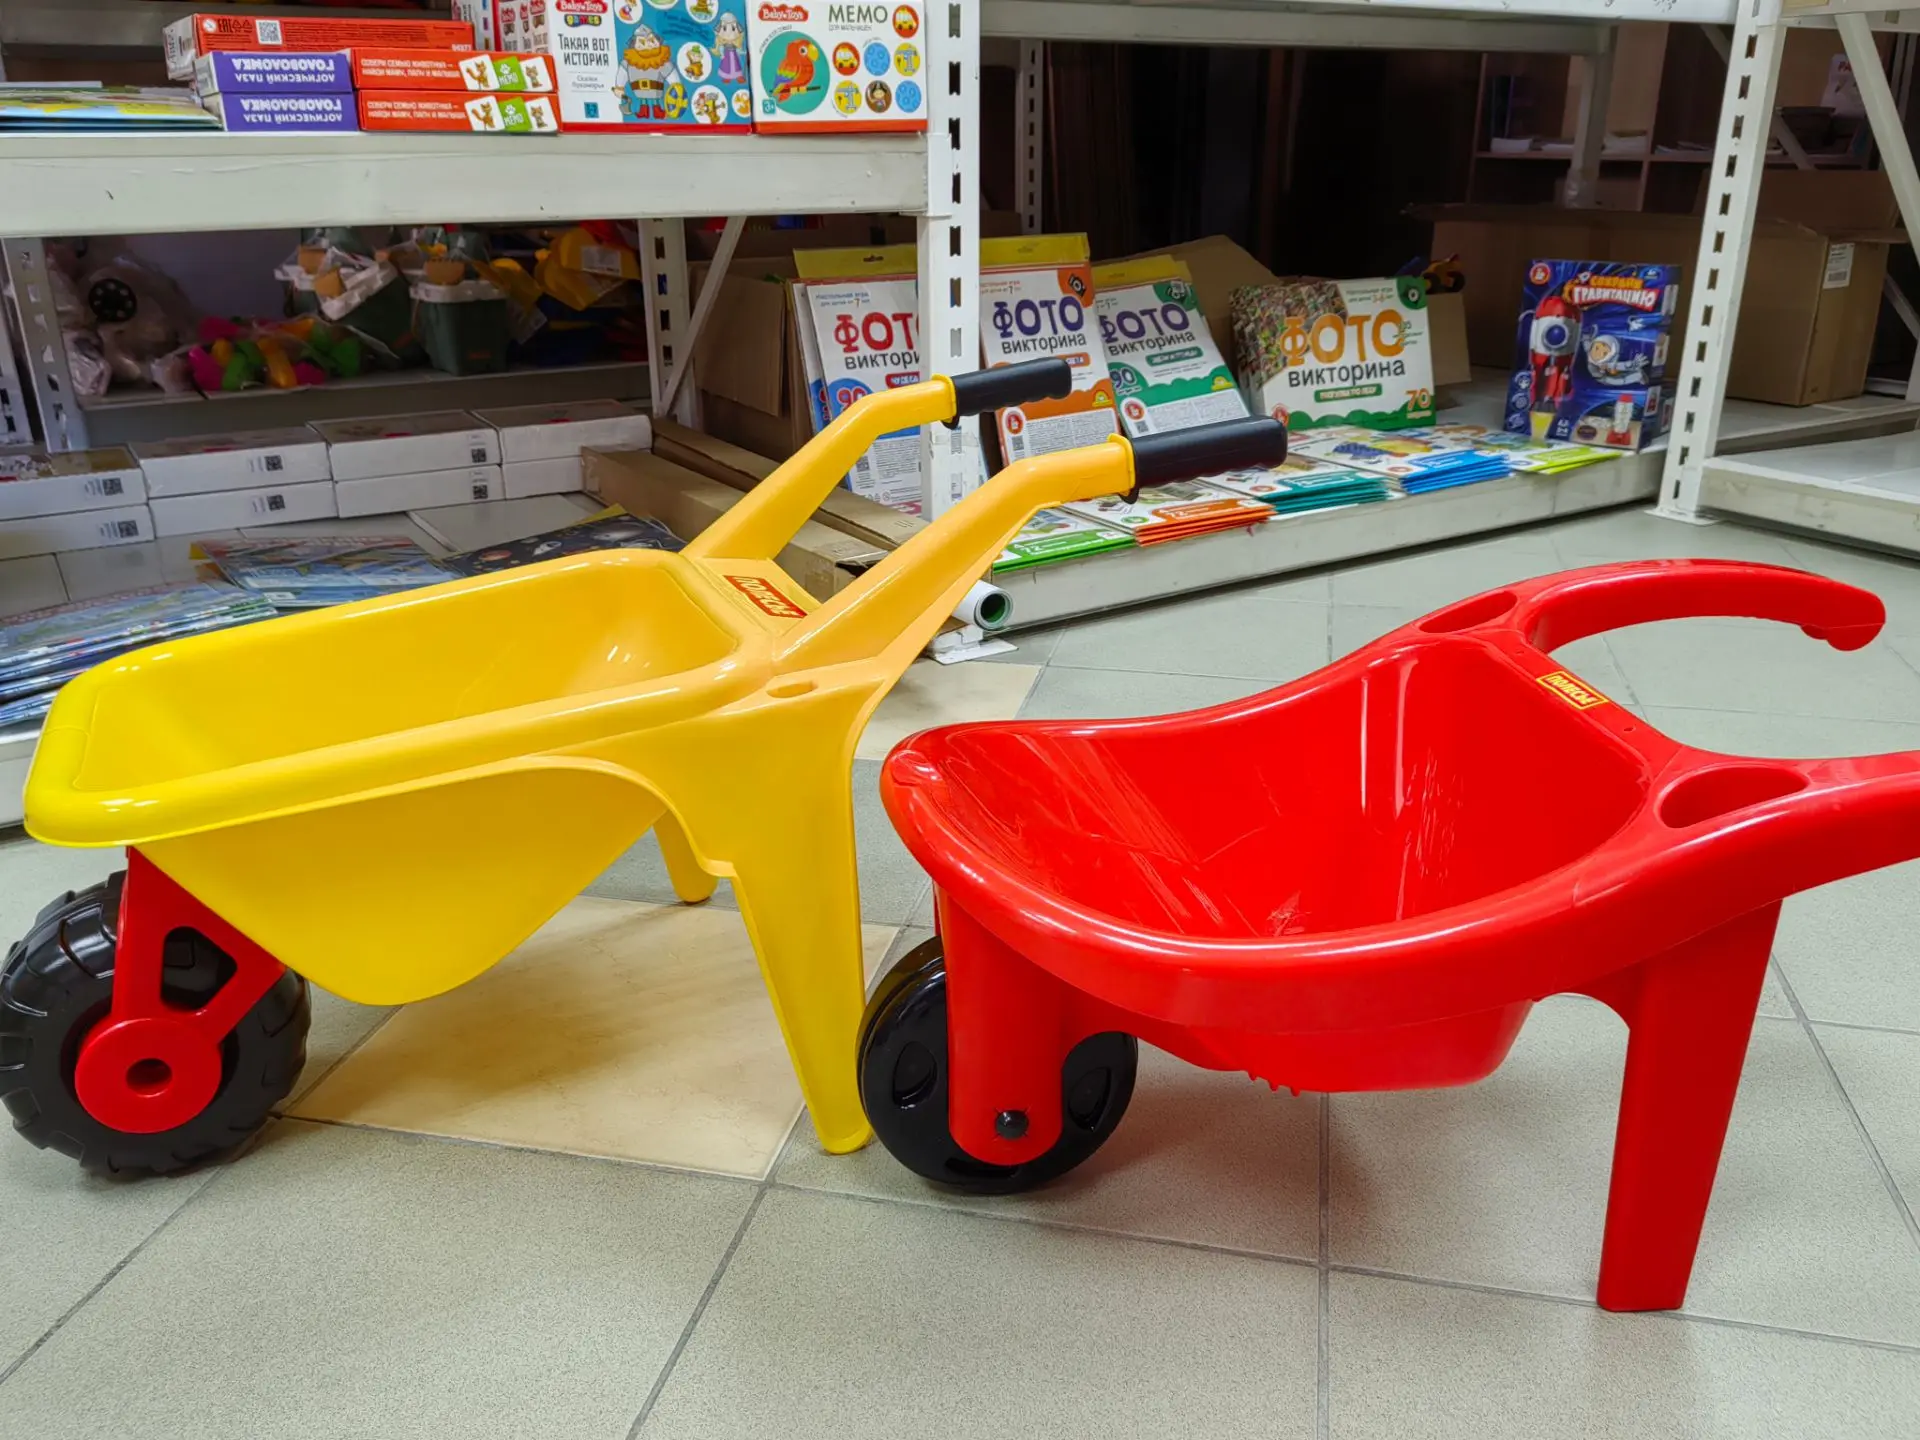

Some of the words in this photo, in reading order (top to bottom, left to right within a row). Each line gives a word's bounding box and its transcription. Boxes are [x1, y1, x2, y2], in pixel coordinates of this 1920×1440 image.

[763, 8, 784, 19] Baby
[786, 9, 804, 20] Toys
[829, 5, 888, 23] МЕМО
[592, 38, 610, 51] ВОТ
[232, 58, 335, 71] ГОЛОВОЛОМКА
[564, 52, 610, 66] ИСТОРИЯ
[235, 73, 263, 83] ПАЗЛ
[266, 73, 335, 84] ЛОГИЧЕСКИЙ
[240, 98, 342, 111] ГОЛОВОЛОМКА
[243, 113, 271, 123] ПАЗЛ
[274, 113, 342, 124] ЛОГИЧЕСКИЙ
[1573, 286, 1656, 307] ГРАВИТАЦИЮ
[993, 296, 1084, 338] ФОТО
[1099, 304, 1190, 344] ФОТО
[834, 312, 920, 353] ФОТ
[1280, 308, 1405, 367] ФОТО
[1002, 333, 1087, 354] викторина
[1108, 331, 1196, 356] викторина
[1289, 359, 1406, 387] викторина
[1406, 388, 1431, 410] 70
